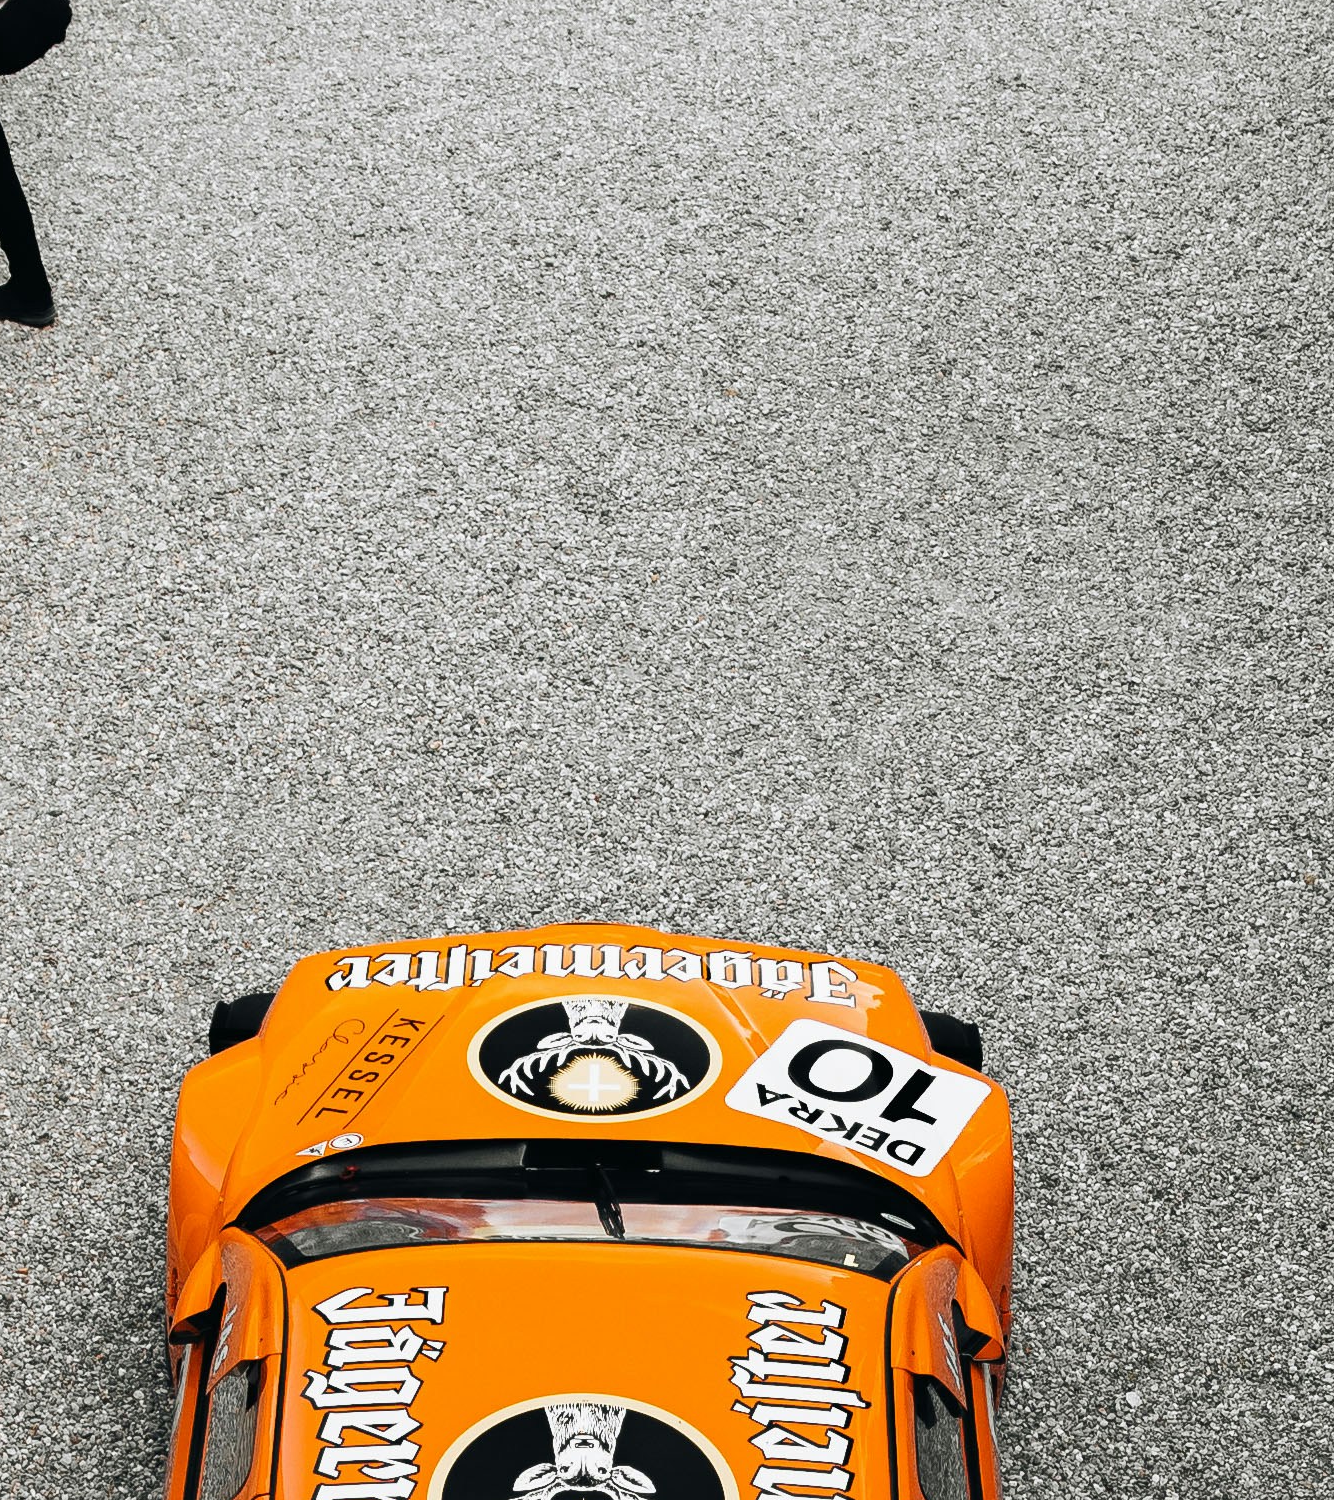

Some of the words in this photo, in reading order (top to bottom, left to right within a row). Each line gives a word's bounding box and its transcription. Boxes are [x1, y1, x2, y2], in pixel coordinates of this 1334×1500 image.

[315, 1017, 426, 1119] KESSEL
[787, 1039, 938, 1126] 10
[755, 1082, 927, 1167] DEKRA
